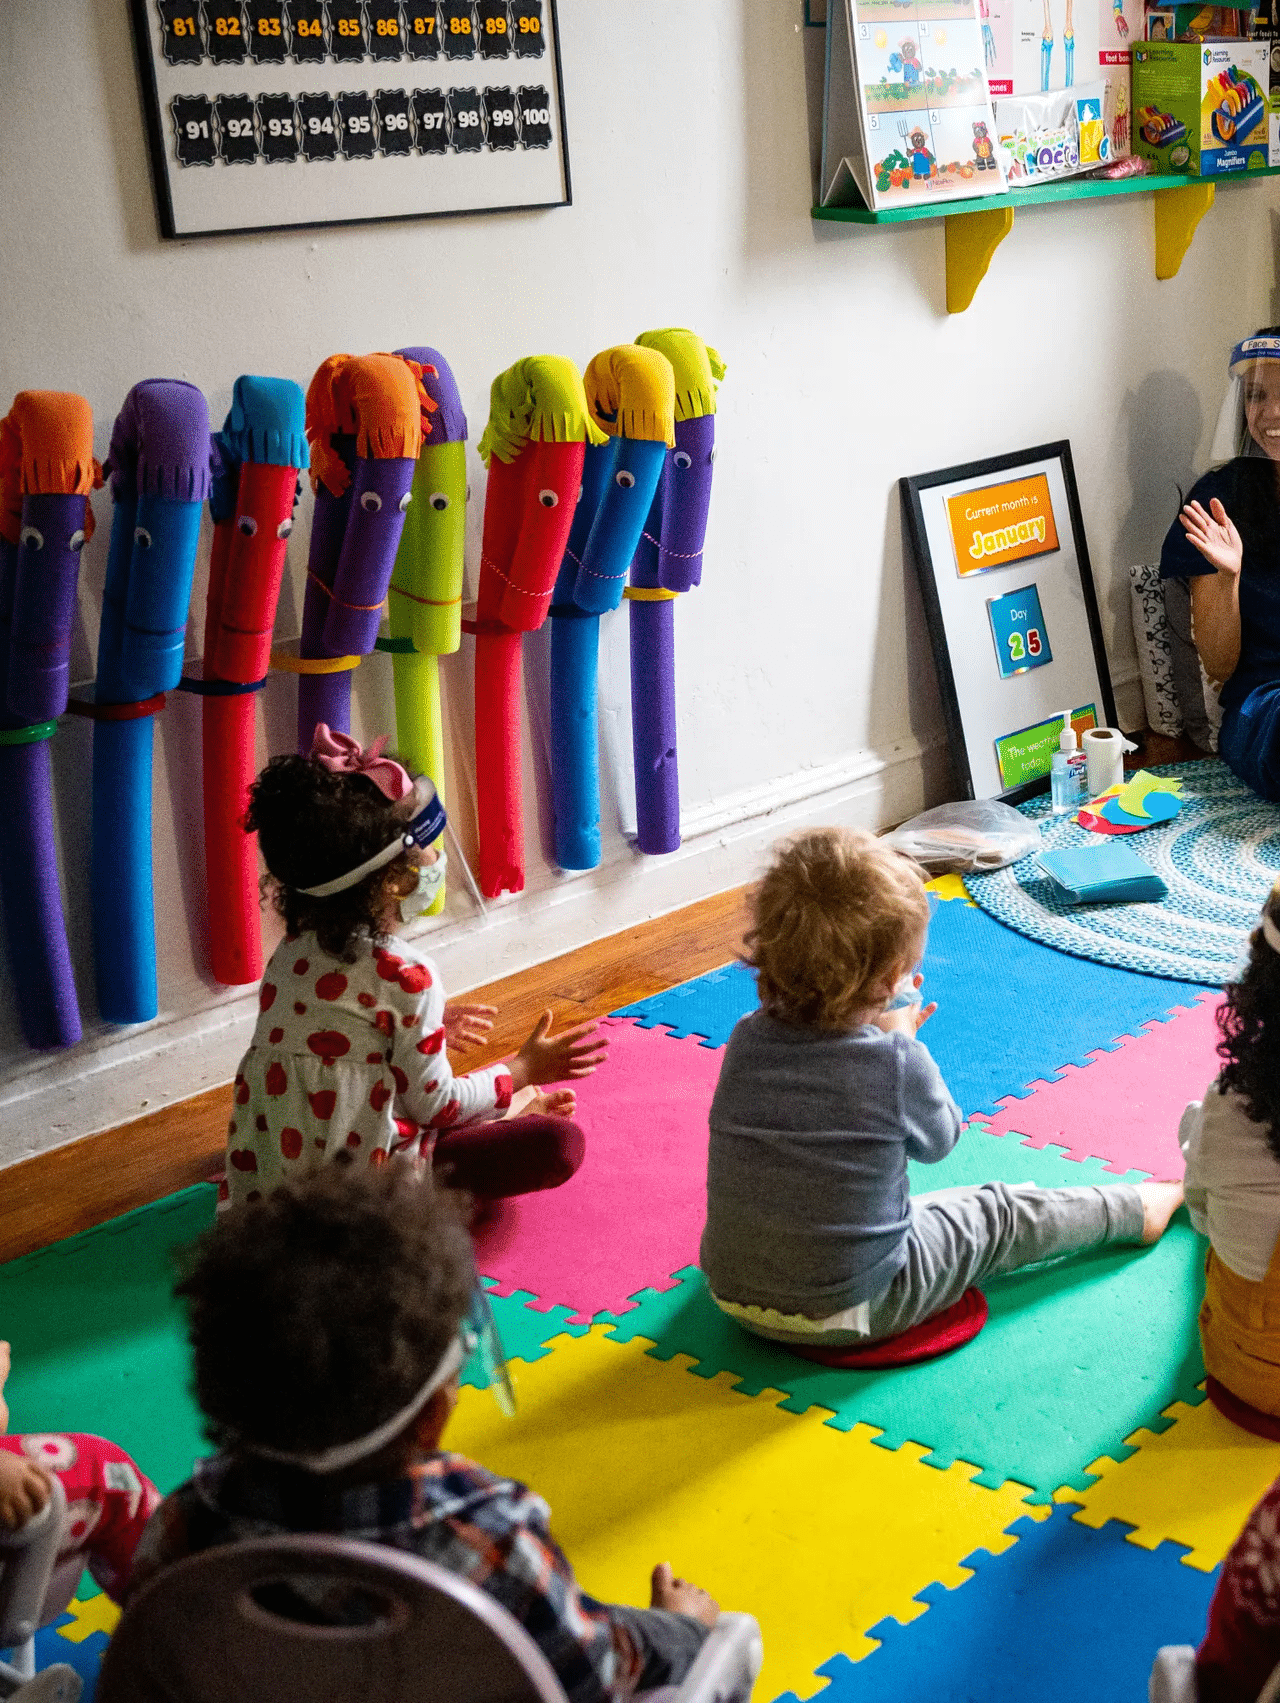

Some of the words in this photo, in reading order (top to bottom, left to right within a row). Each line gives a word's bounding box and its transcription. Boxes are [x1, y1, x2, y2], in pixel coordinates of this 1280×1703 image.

[173, 17, 195, 36] 81
[215, 17, 241, 36] 82
[258, 18, 281, 36] 83
[297, 19, 322, 37] 84
[338, 19, 360, 36] 85
[376, 18, 399, 36] 86
[414, 17, 435, 35] 87
[450, 17, 472, 35] 88
[485, 17, 507, 35] 89
[519, 16, 540, 34] 90
[861, 25, 868, 37] 3
[186, 120, 209, 139] 91
[227, 118, 253, 138] 92
[268, 118, 294, 137] 93
[308, 116, 334, 135] 94
[348, 116, 371, 134] 95
[385, 113, 408, 131] 96
[423, 112, 444, 130] 97
[458, 110, 480, 128] 98
[492, 109, 514, 127] 99
[523, 108, 549, 126] 100
[871, 116, 878, 128] 5
[931, 112, 937, 123] 6
[1216, 156, 1246, 168] Magnifiers
[1247, 340, 1268, 349] Face
[965, 504, 1000, 521] Current
[1001, 495, 1030, 513] month
[1030, 496, 1039, 505] is
[969, 515, 1046, 560] January
[1010, 608, 1028, 621] Day
[1007, 746, 1026, 760] The
